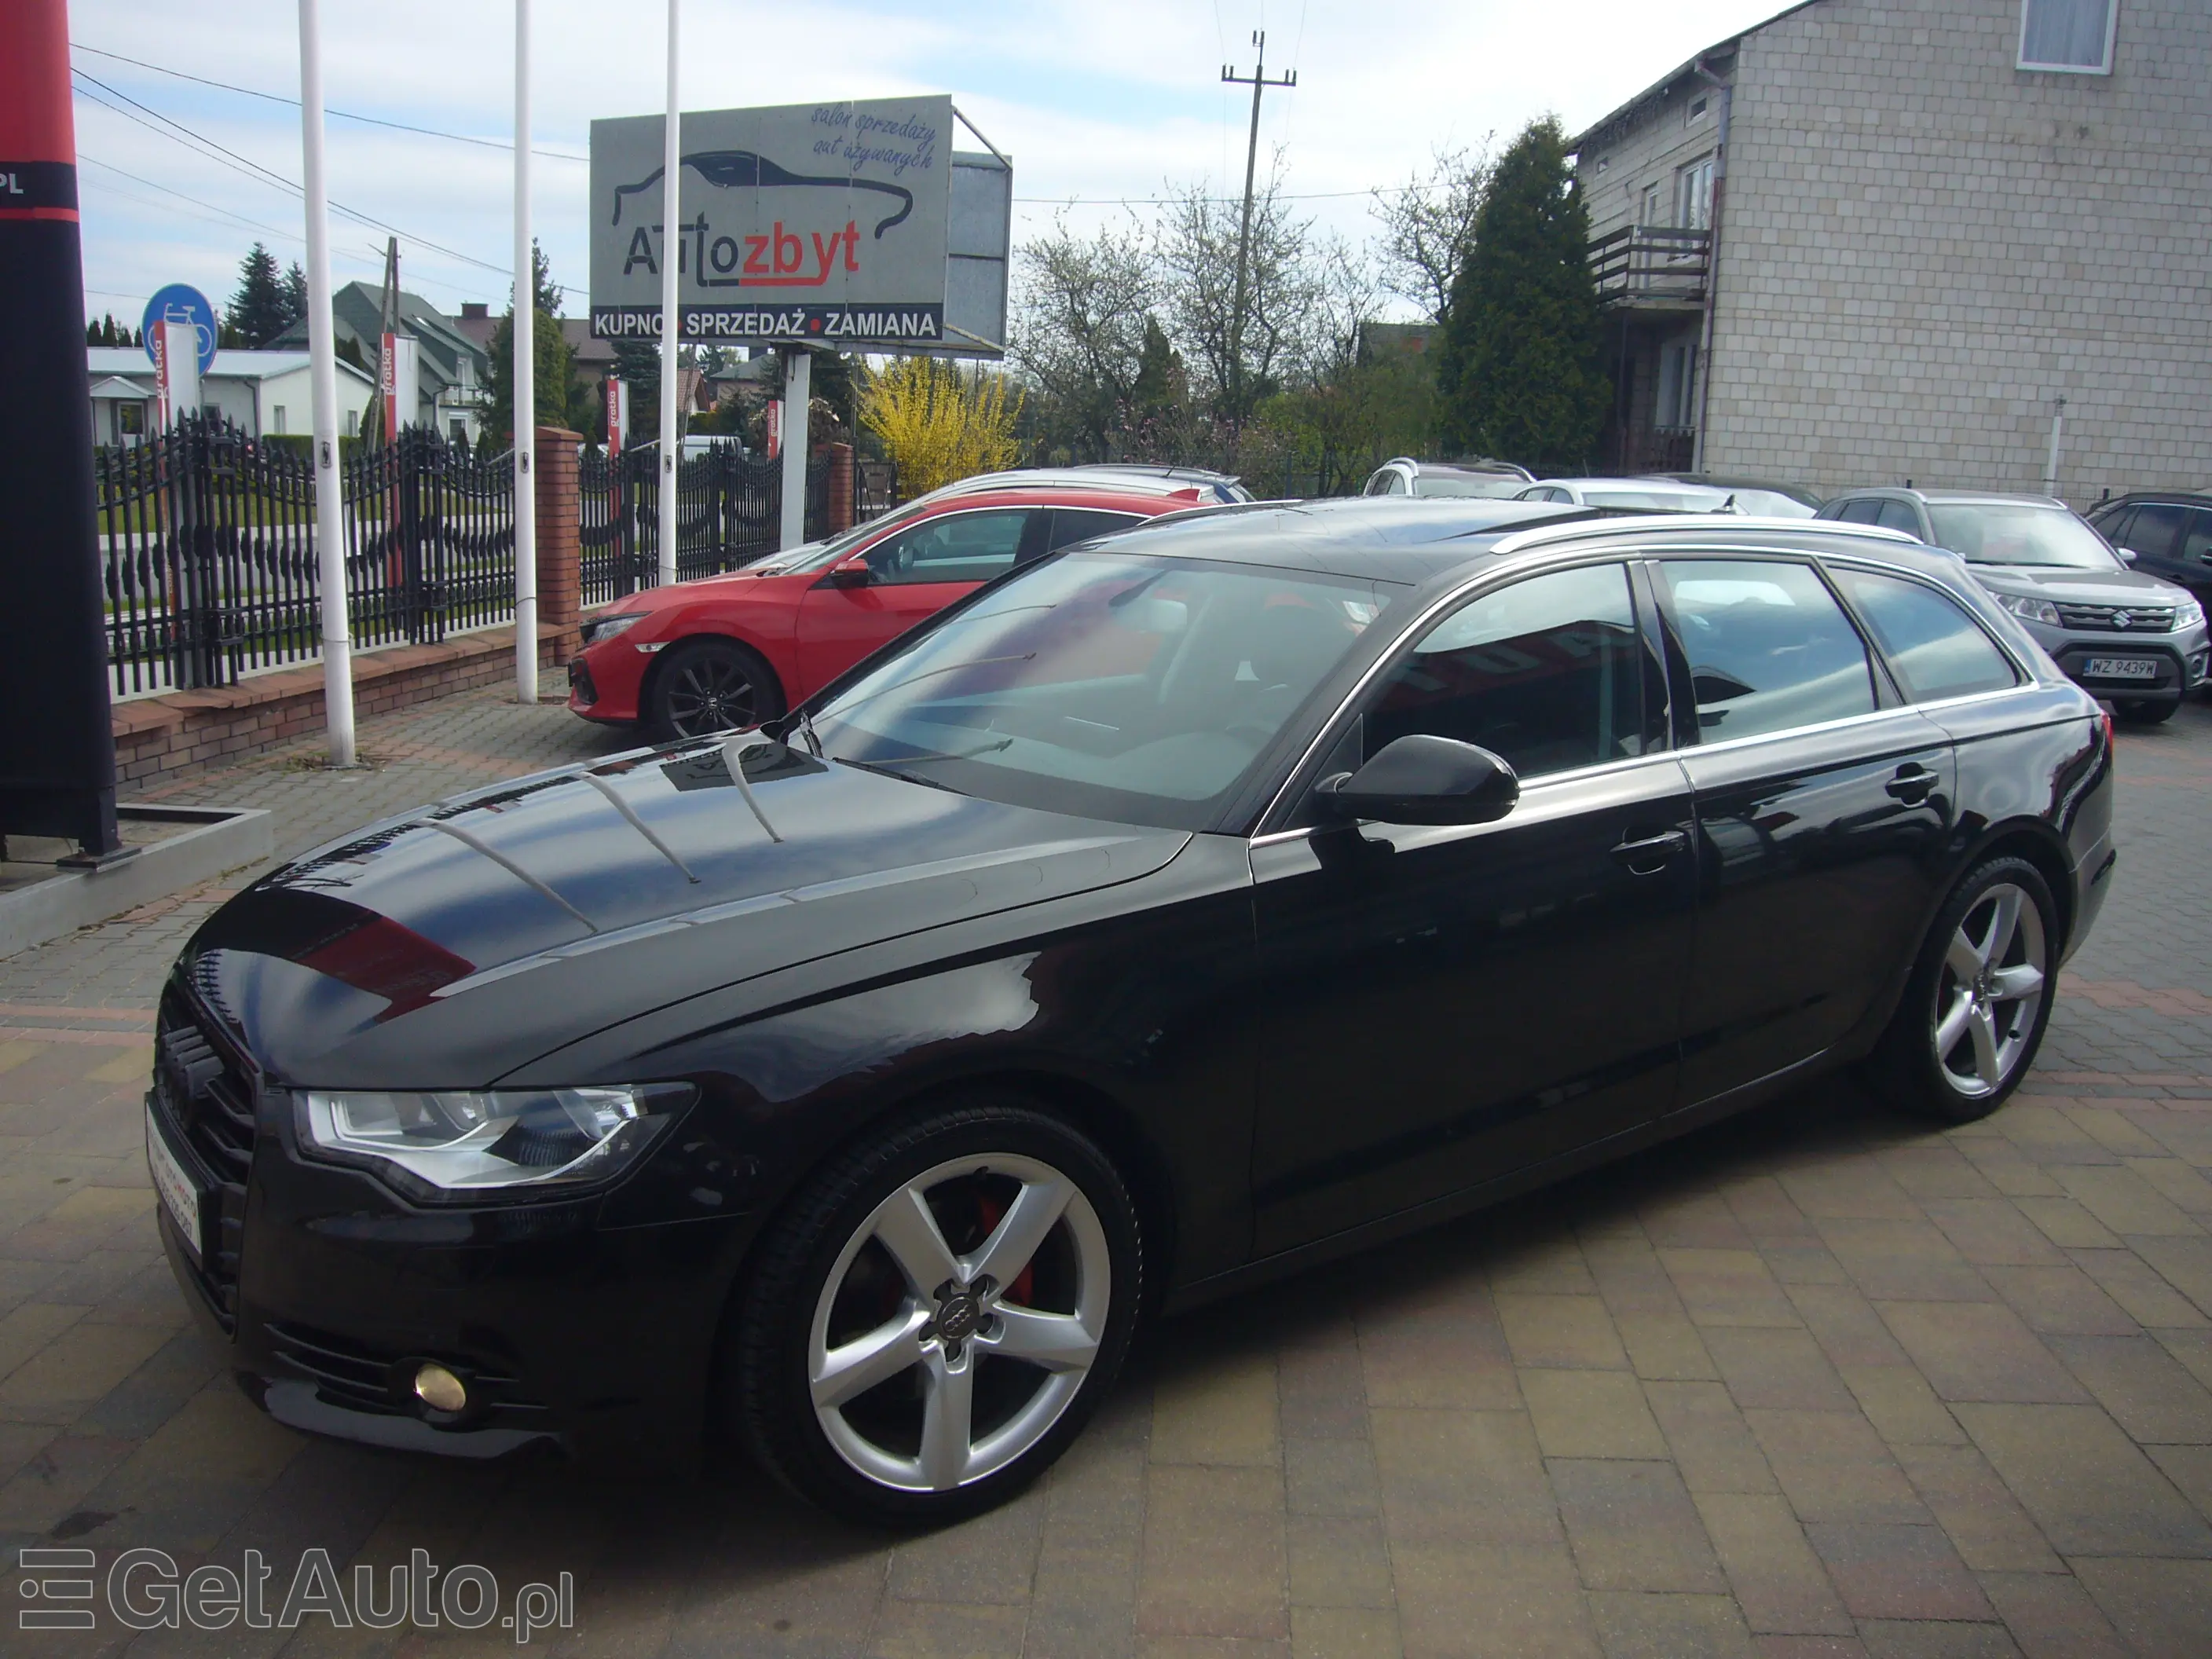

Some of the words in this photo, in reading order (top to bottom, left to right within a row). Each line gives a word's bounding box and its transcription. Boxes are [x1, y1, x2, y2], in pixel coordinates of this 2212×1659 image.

[811, 102, 853, 128] salon
[855, 114, 936, 152] sprzedaży
[813, 136, 843, 156] aut
[595, 313, 663, 335] KUPNO
[686, 308, 805, 335] SPRZEDAŻ
[824, 313, 936, 336] ZAMIANA
[383, 347, 396, 396] gratka
[610, 390, 620, 427] gratka
[2092, 660, 2112, 673] WZ
